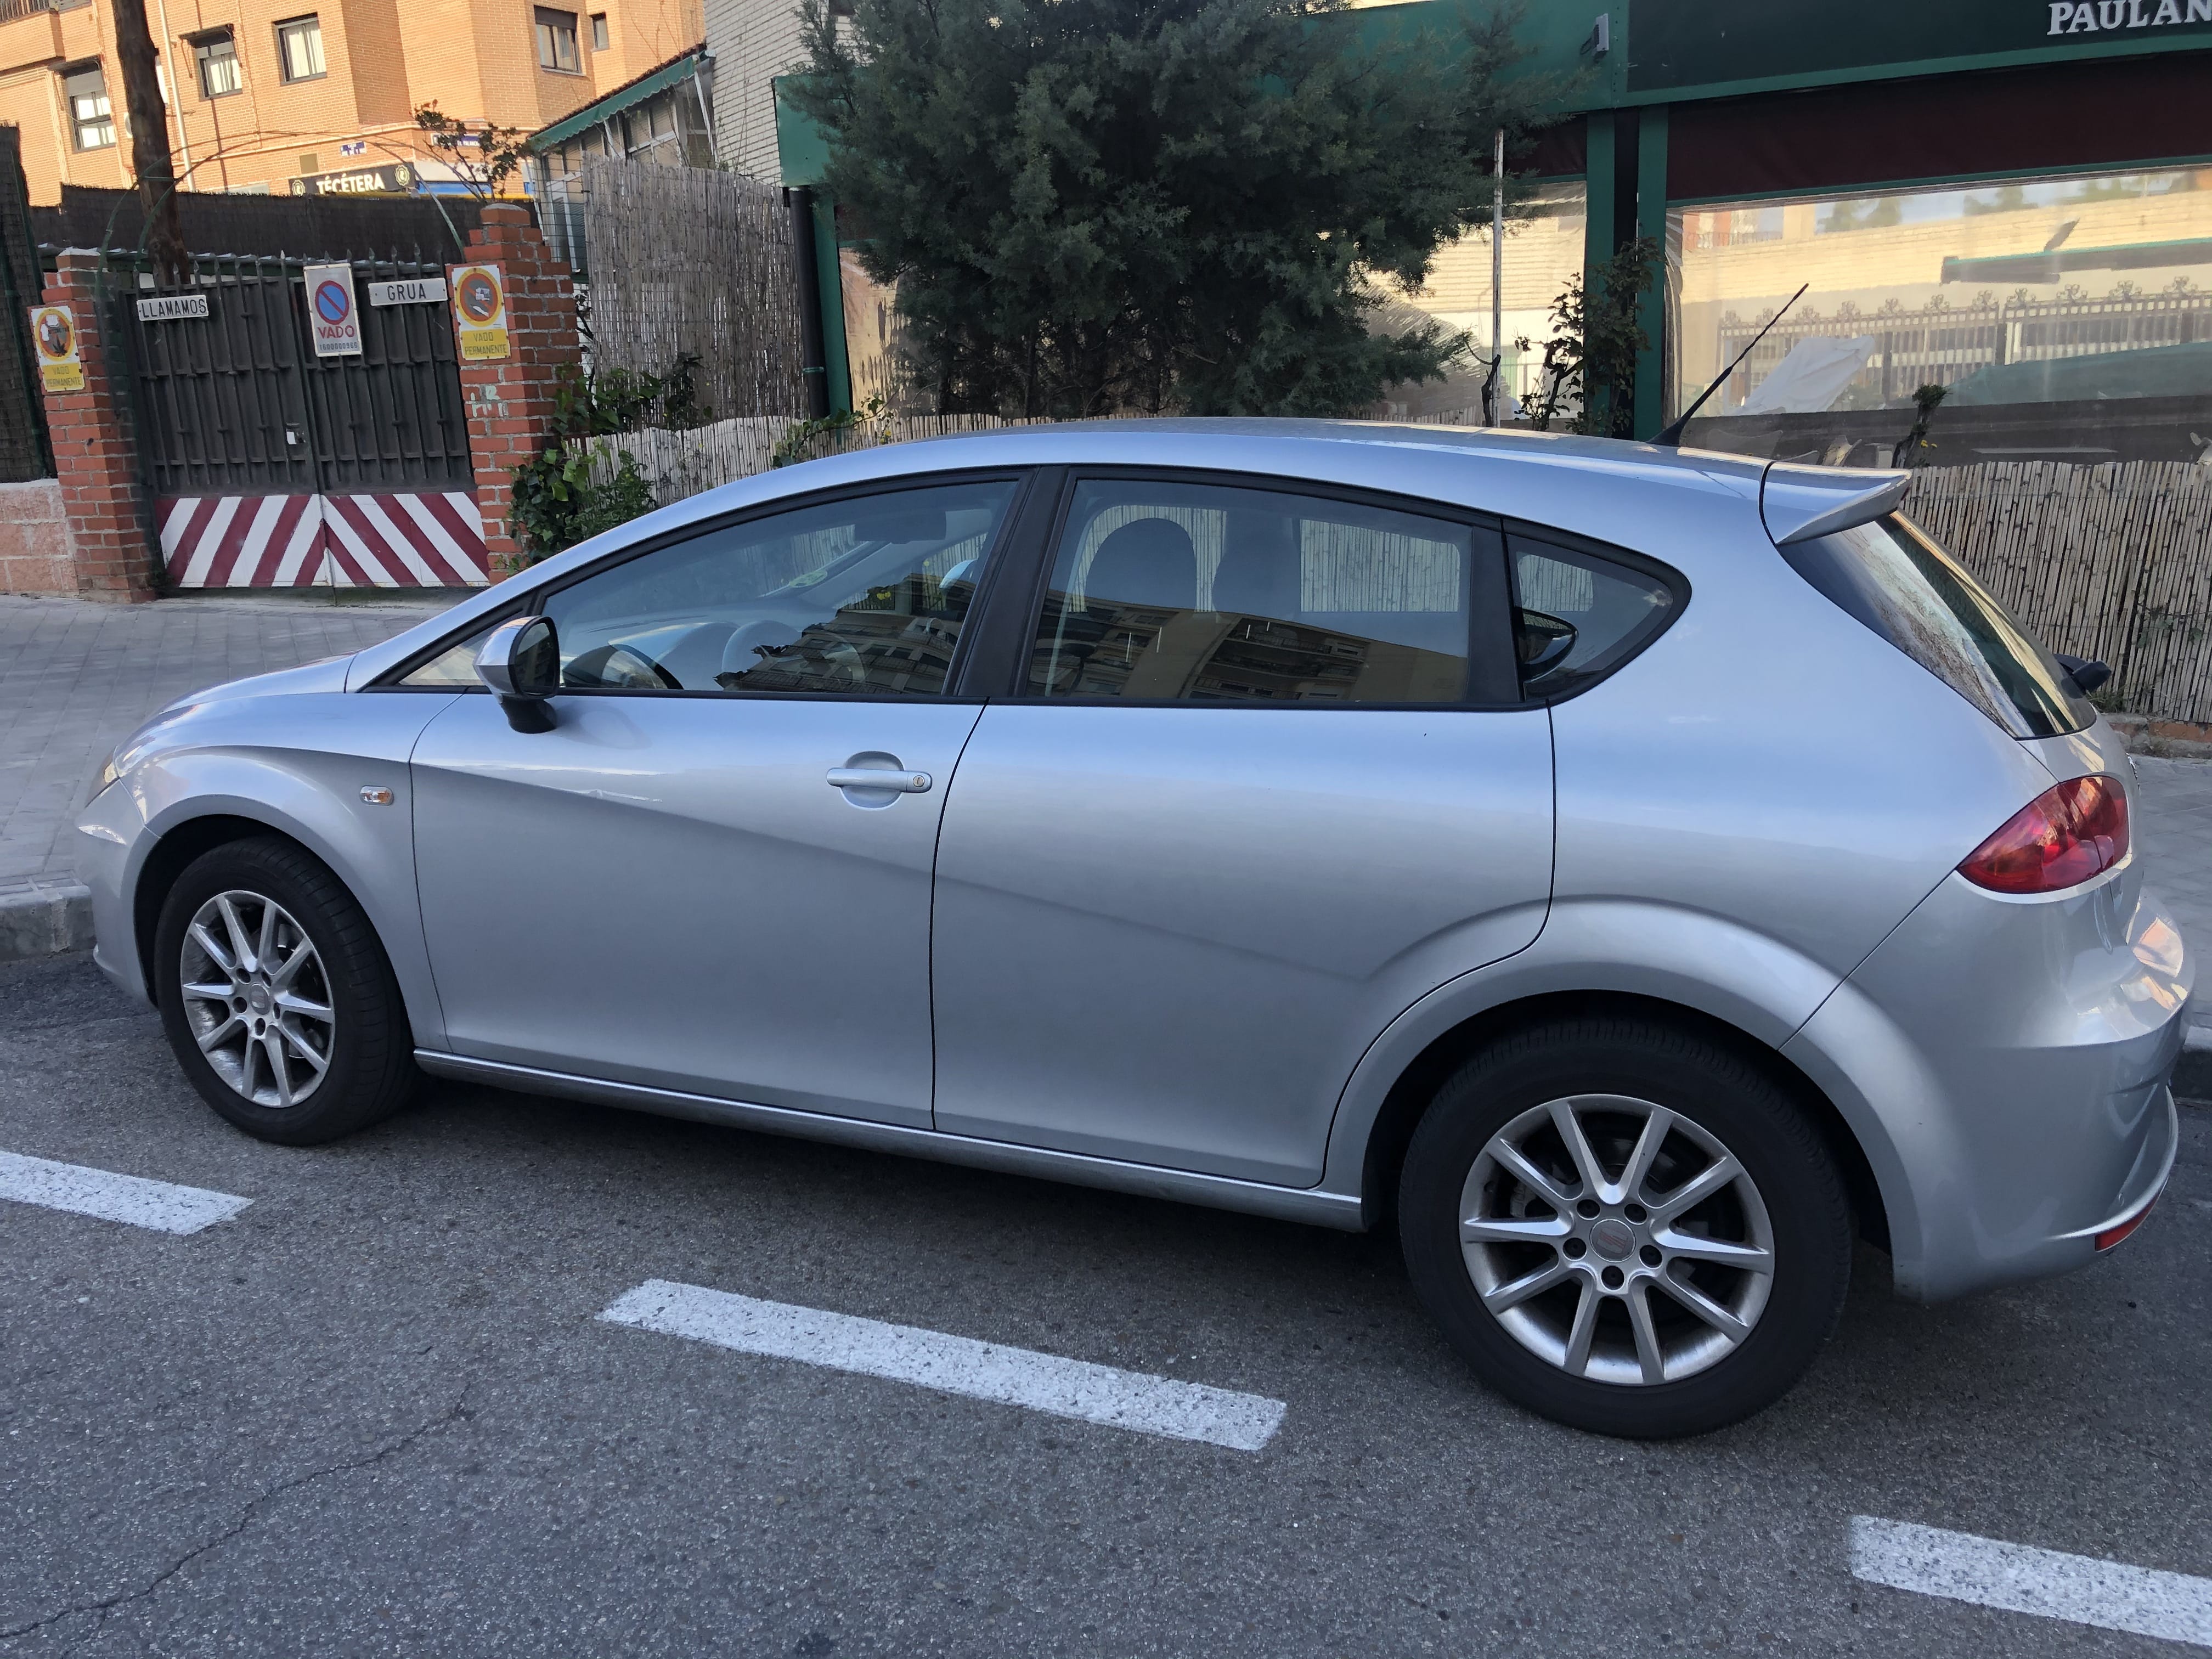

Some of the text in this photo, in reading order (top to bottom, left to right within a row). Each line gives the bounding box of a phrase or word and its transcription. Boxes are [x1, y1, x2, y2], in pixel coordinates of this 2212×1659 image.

[2047, 0, 2212, 35] PAULAN
[316, 173, 386, 194] TÉCÉTERA
[387, 283, 426, 301] GRUA
[142, 298, 206, 318] LLAMAMOS
[317, 325, 355, 339] VADO
[473, 332, 494, 342] VADO
[465, 344, 507, 356] PERMANENTE
[52, 365, 69, 375] VADO
[46, 377, 82, 387] PERMANENTE
